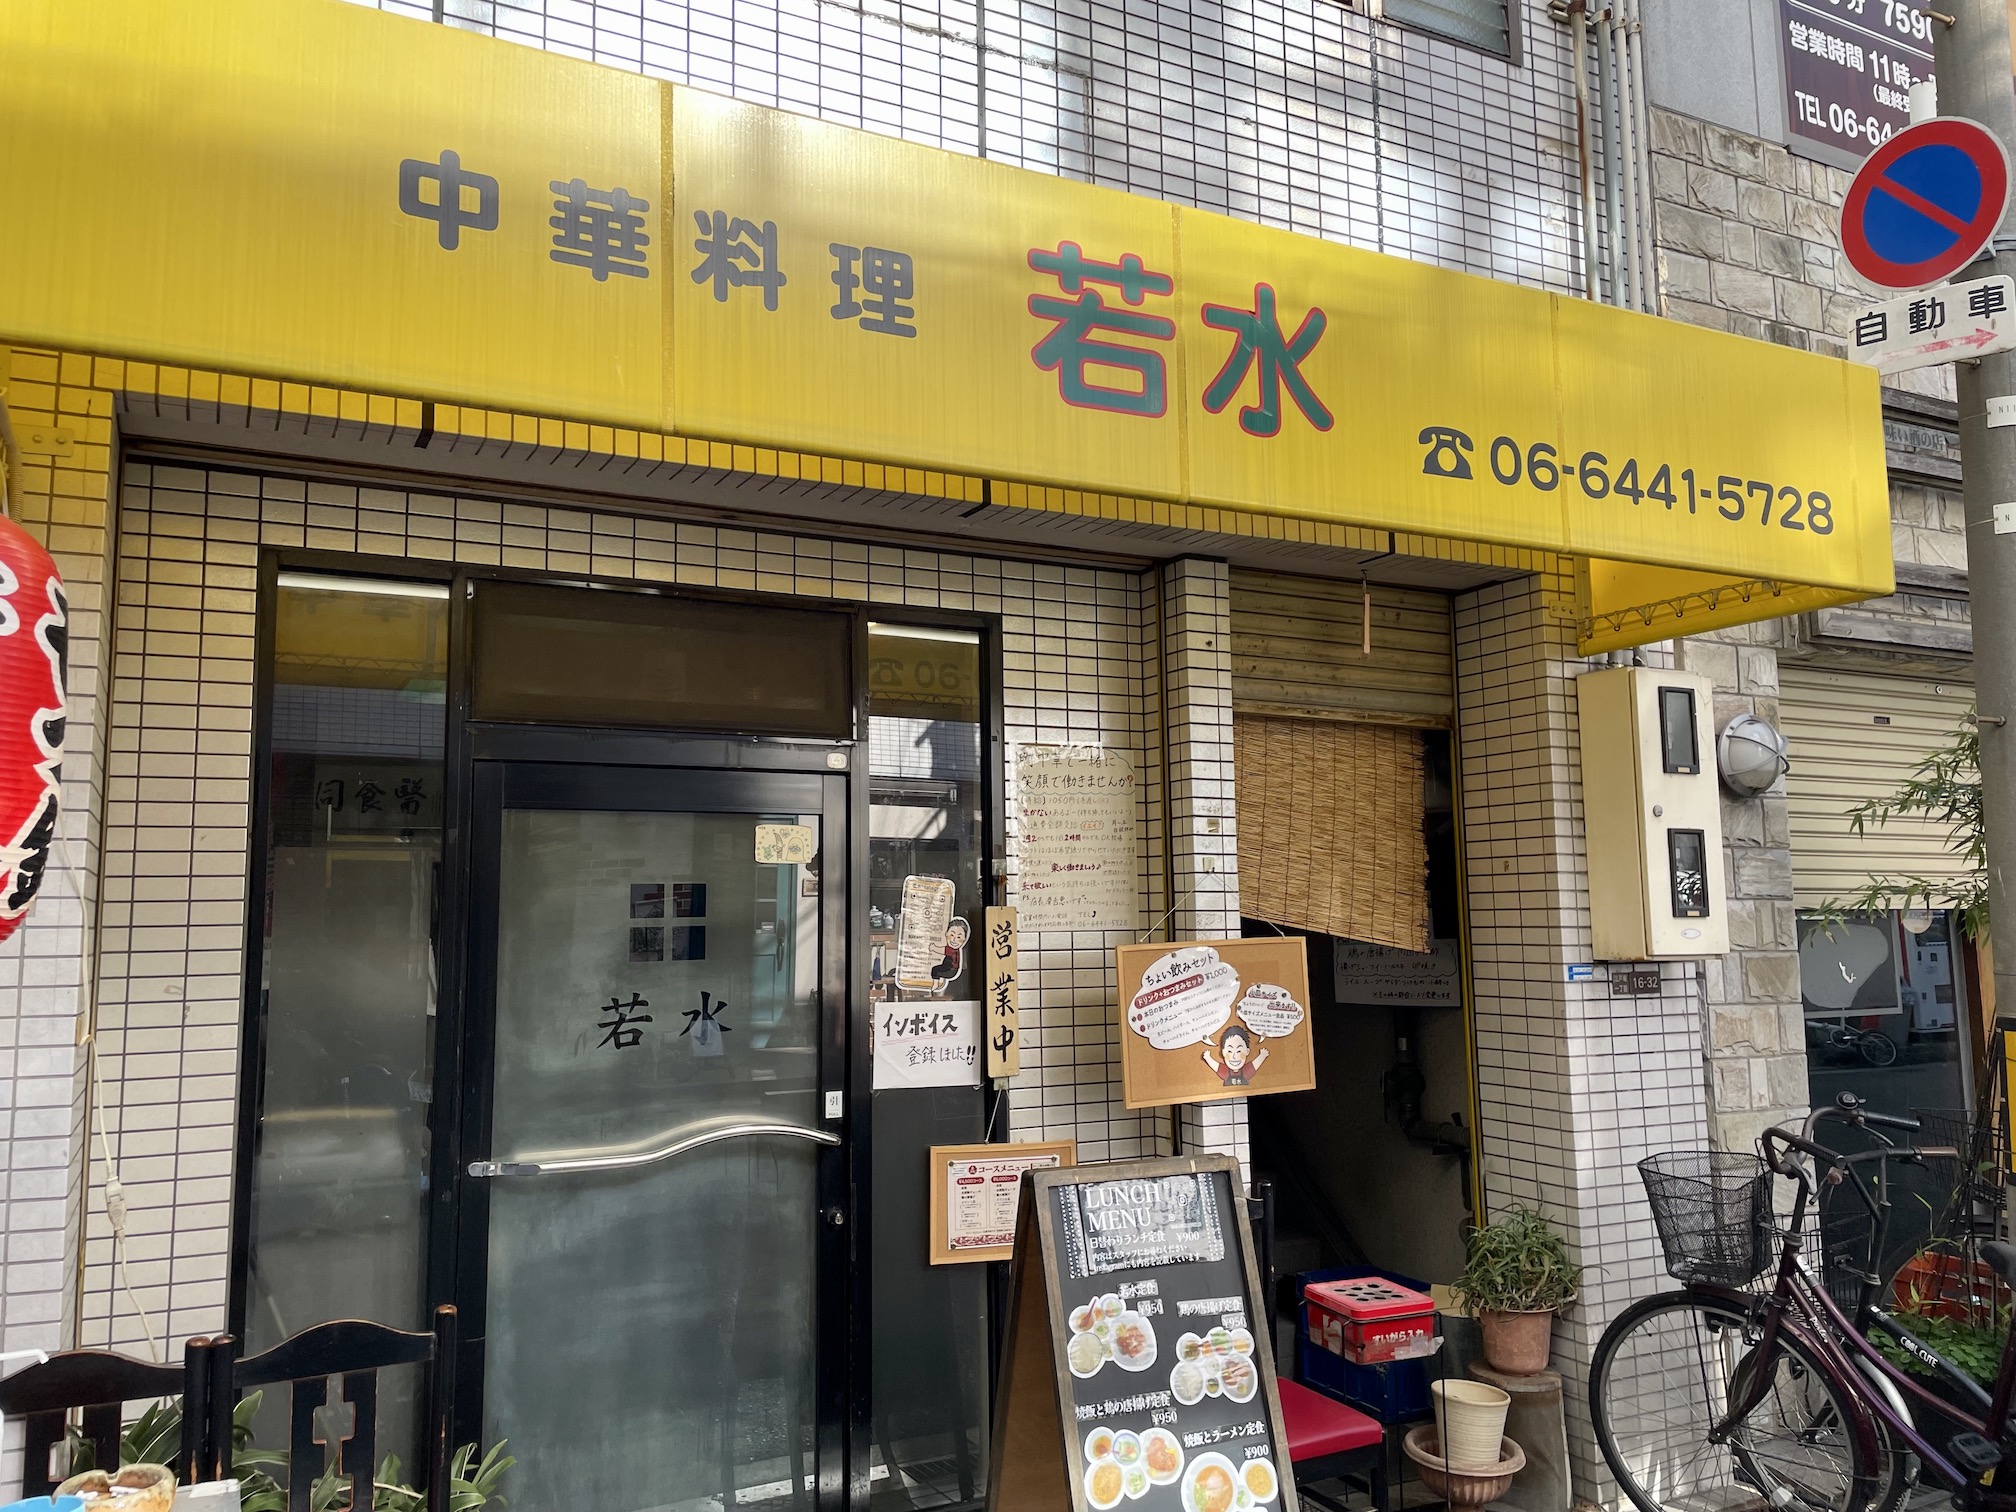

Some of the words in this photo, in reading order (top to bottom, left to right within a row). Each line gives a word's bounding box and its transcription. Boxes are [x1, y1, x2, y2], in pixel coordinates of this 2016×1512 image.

[1789, 20, 1865, 73] 営業時間
[1795, 91, 1827, 128] TEL
[1829, 103, 1893, 146] 06-64
[399, 149, 917, 338] 中華料理
[1855, 284, 2007, 347] 自動車
[1027, 240, 1334, 438] 若水
[1489, 436, 1834, 536] 06-6441-5728
[1146, 953, 1214, 986] ちょい飲みセット
[990, 920, 1016, 1064] 営業中
[1633, 976, 1659, 989] 16-32
[595, 991, 732, 1050] 若水
[1144, 999, 1179, 1017] 本日のおつまみ
[883, 1012, 958, 1037] インボイス
[978, 1165, 1029, 1174] コースメニュー
[1085, 1183, 1161, 1208] LUNCH
[1087, 1207, 1152, 1232] MENU
[1090, 1231, 1166, 1249] 日替わりランチ定食
[1176, 1231, 1200, 1243] ¥900
[1118, 1282, 1158, 1298] 若水定食
[1138, 1301, 1163, 1316] ¥950
[1222, 1315, 1247, 1329] ¥950
[1919, 1349, 1939, 1368] CUTE
[1152, 1411, 1177, 1425] ¥950
[1244, 1445, 1269, 1459] ¥900
